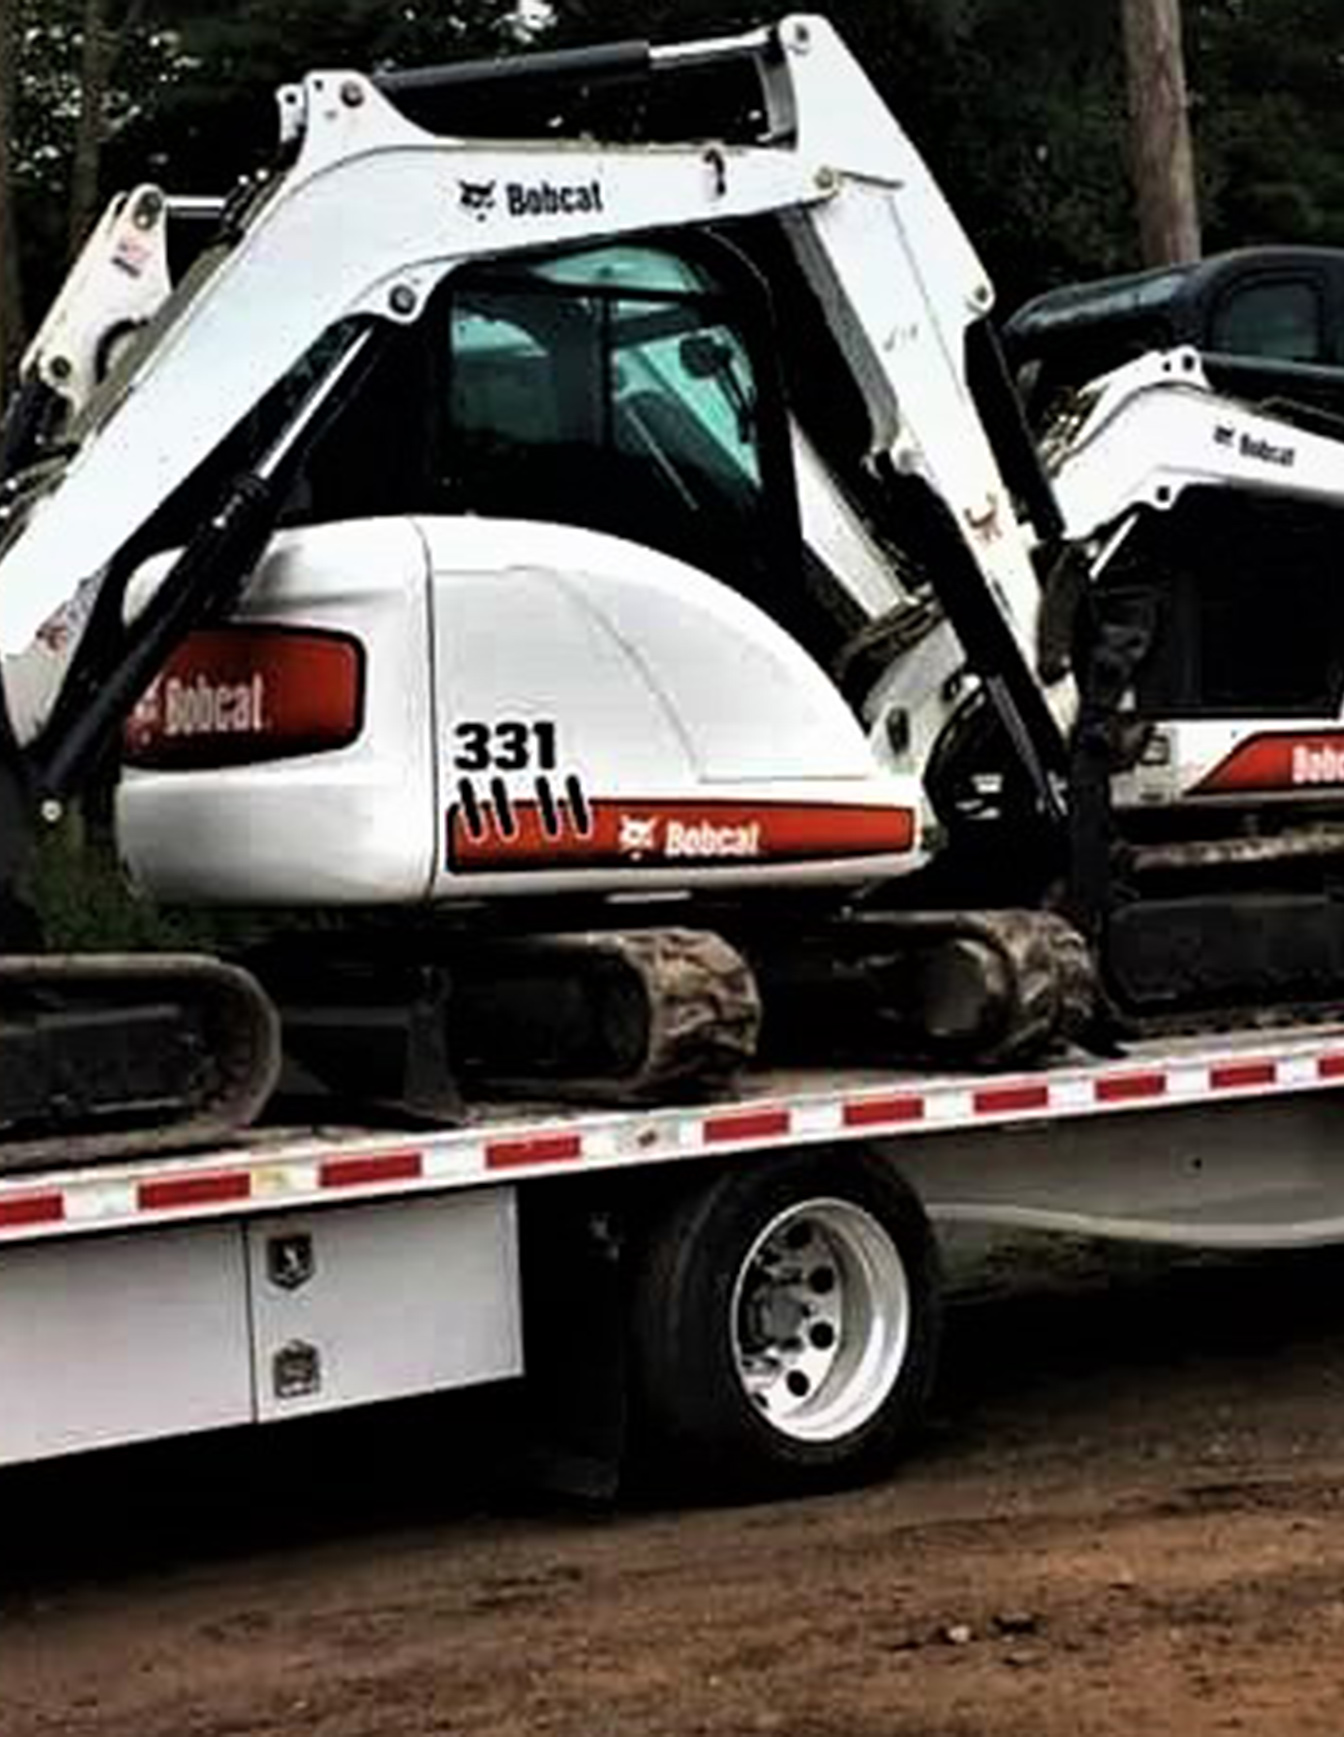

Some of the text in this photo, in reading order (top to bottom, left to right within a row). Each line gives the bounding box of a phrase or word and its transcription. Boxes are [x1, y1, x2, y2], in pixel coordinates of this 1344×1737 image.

[506, 181, 604, 216] Bobcat
[164, 674, 264, 736] Bobcat
[453, 722, 556, 770] 331
[664, 820, 760, 858] Bobcat
